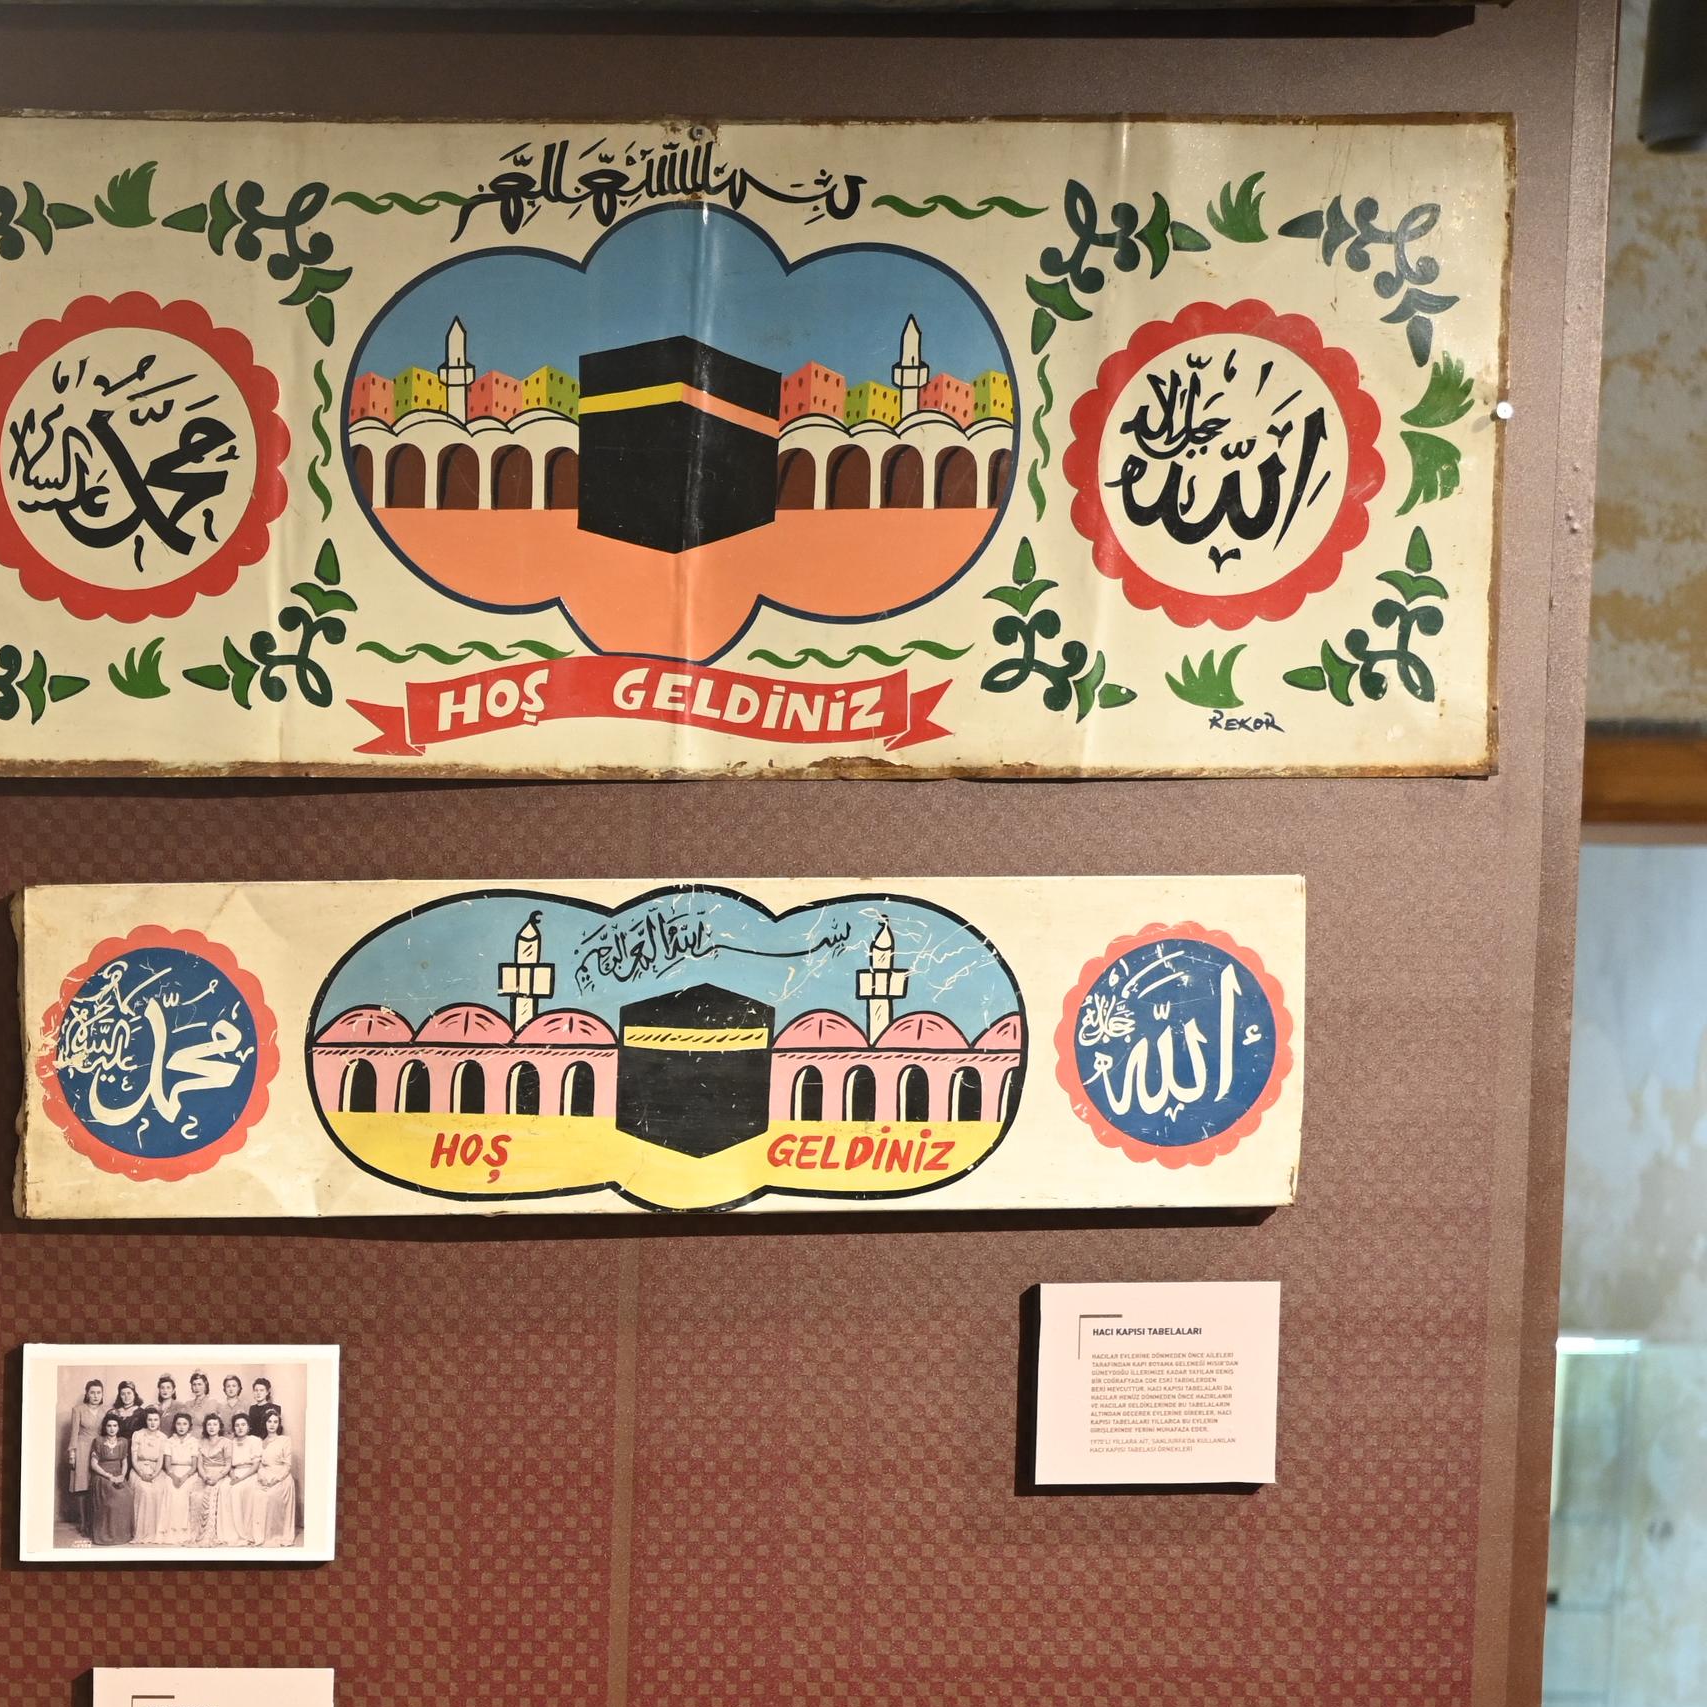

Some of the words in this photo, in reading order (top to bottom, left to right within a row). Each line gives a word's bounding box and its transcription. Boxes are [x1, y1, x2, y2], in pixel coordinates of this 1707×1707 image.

[433, 665, 555, 730] HOŞ
[607, 666, 891, 737] GELDİNİZ
[430, 1133, 512, 1184] HOŞ
[762, 1121, 960, 1177] GELDİNİZ
[1093, 1328, 1114, 1336] HACI
[1116, 1328, 1145, 1336] KAPISI
[1147, 1327, 1202, 1335] TABELALARI
